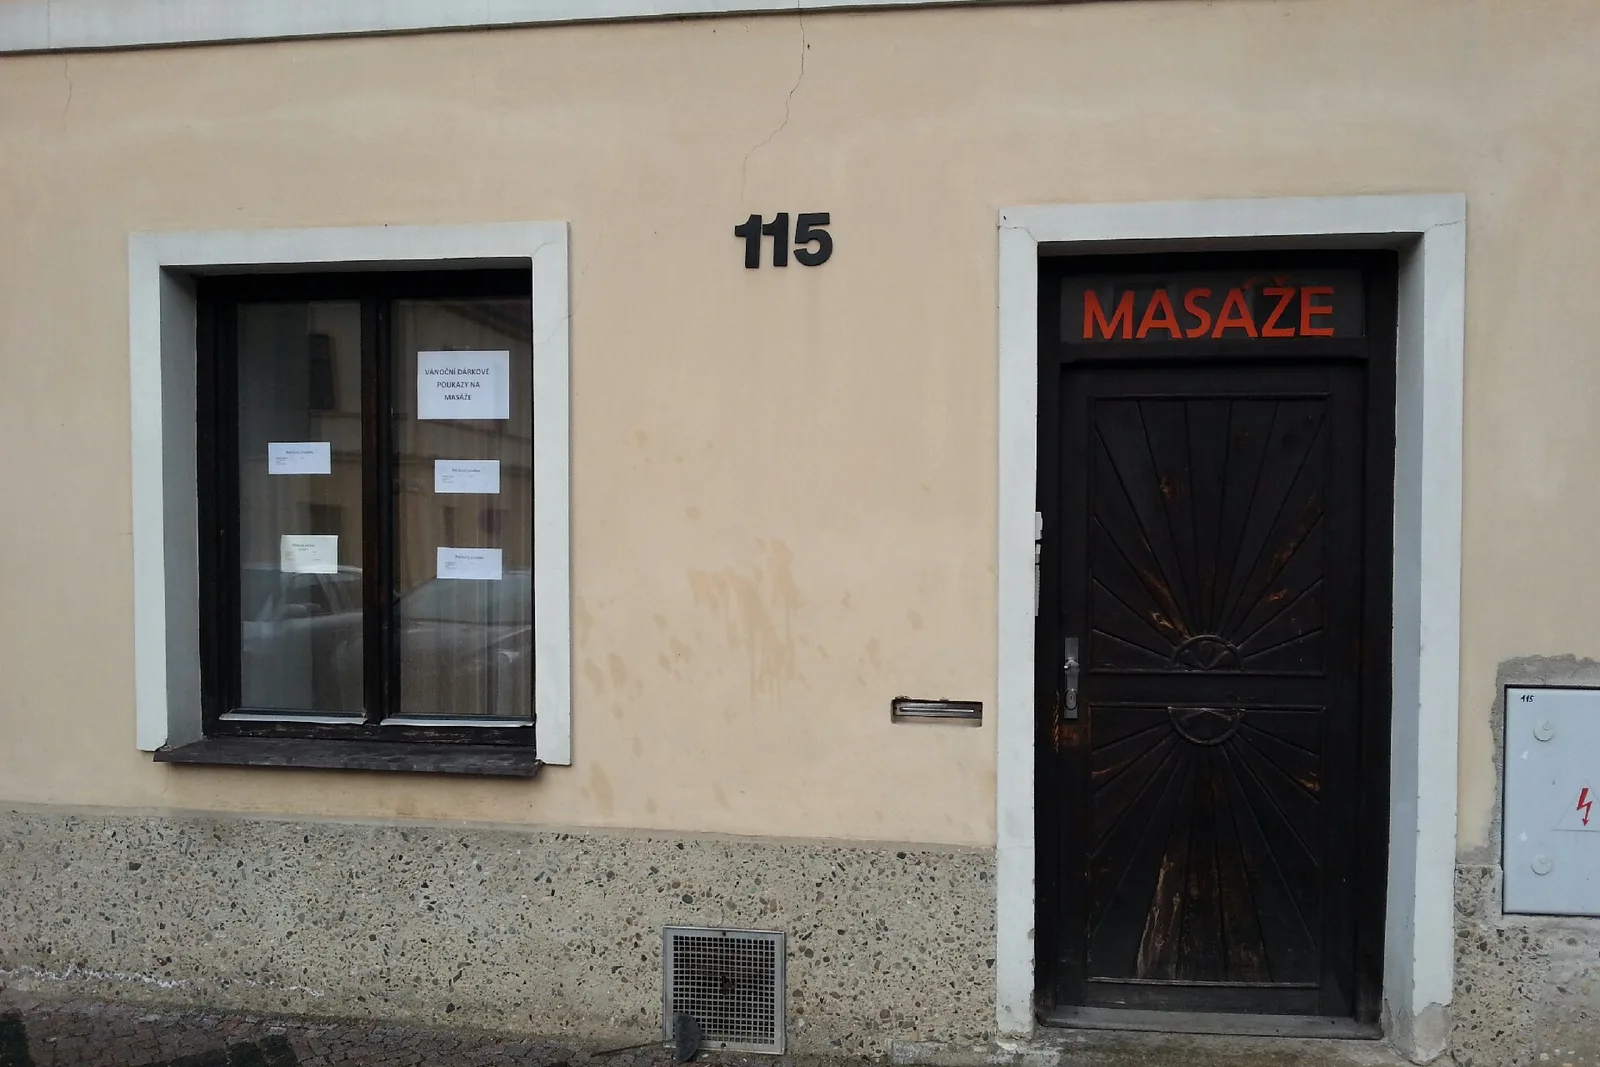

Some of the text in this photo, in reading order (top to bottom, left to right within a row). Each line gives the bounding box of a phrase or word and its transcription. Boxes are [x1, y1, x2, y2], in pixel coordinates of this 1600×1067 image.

[734, 212, 833, 268] 115
[424, 366, 490, 375] VÁNOČNÍ DÁRKOVÉ
[444, 393, 472, 401] MASÁŽE
[1520, 694, 1535, 703] 115
